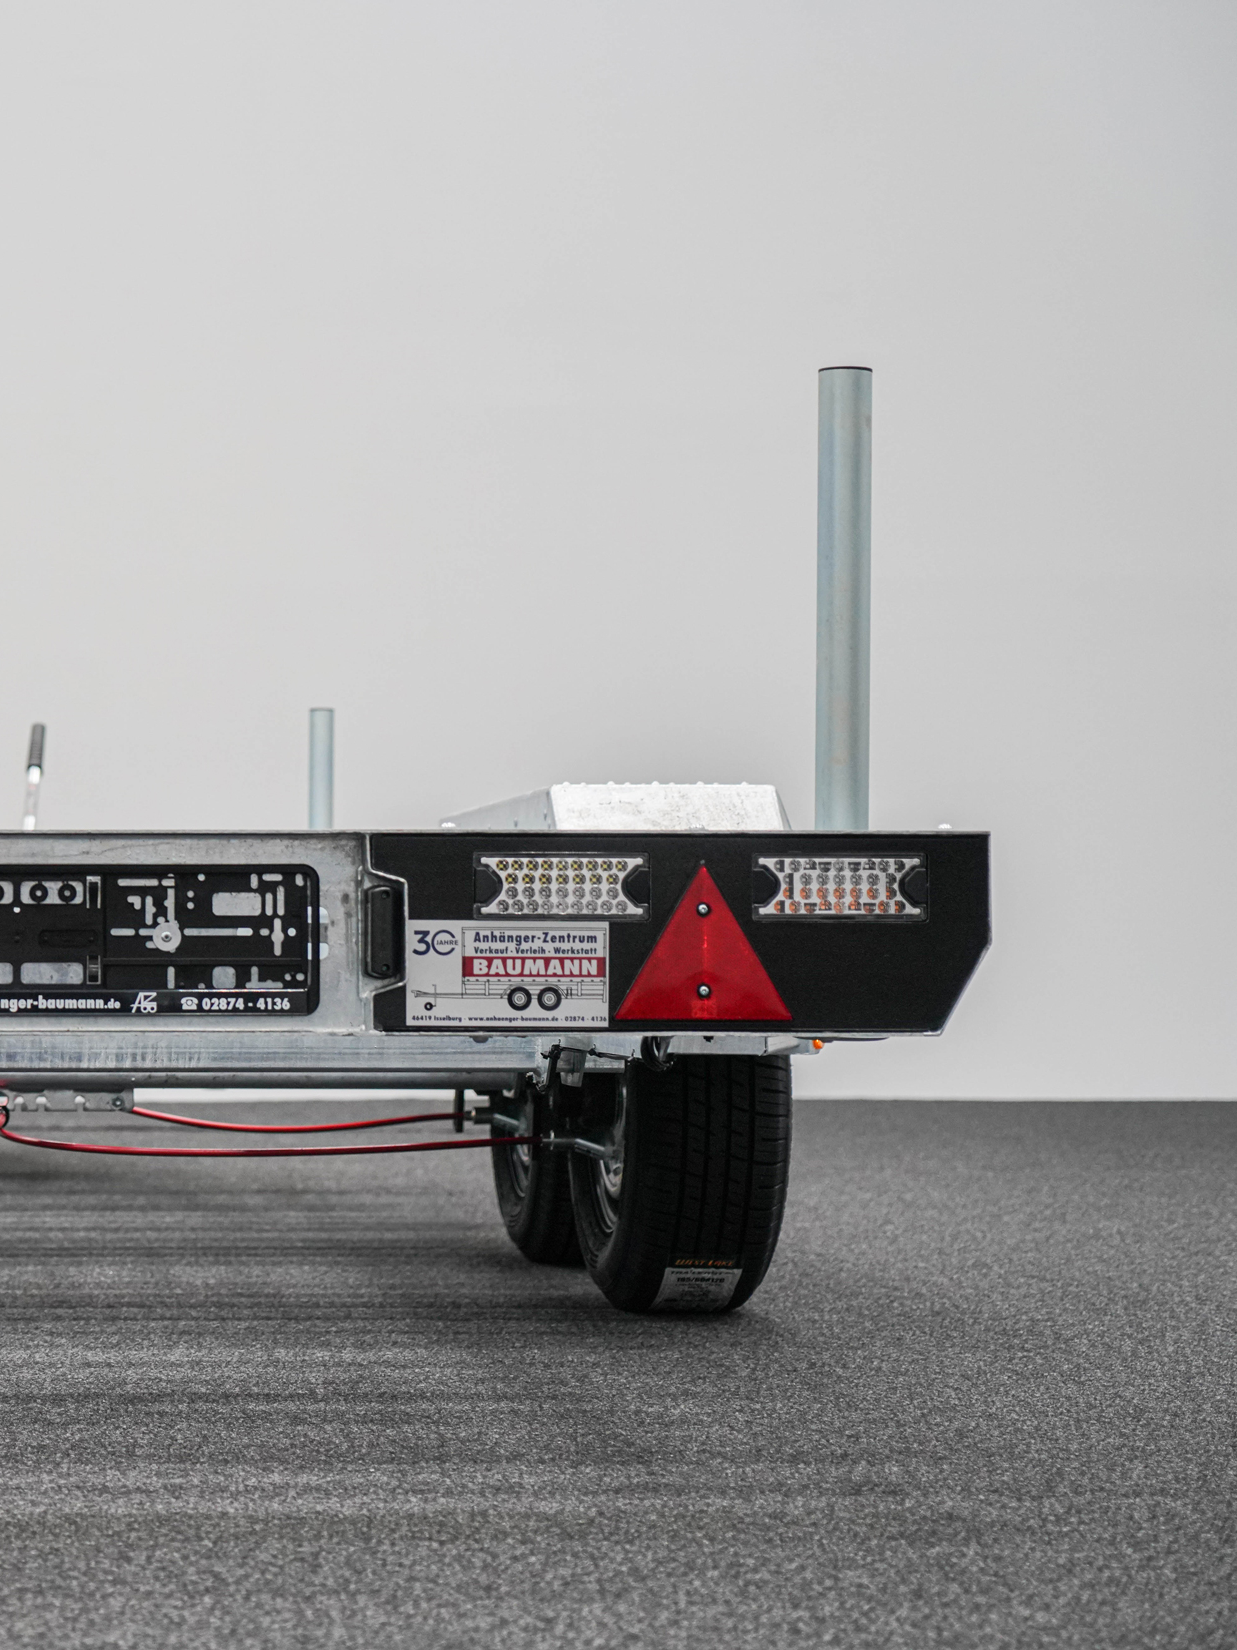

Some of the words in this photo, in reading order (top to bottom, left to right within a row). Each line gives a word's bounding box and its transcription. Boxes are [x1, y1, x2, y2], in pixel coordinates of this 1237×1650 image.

[473, 931, 598, 946] Anhänger-Zentrum
[474, 946, 509, 955] Verkauf
[515, 946, 546, 955] Verleih
[553, 946, 598, 955] Werkstatt
[472, 958, 598, 976] BAUMANN
[201, 997, 245, 1010] 02874
[256, 997, 291, 1010] 4136
[433, 1015, 462, 1023] Isselburg
